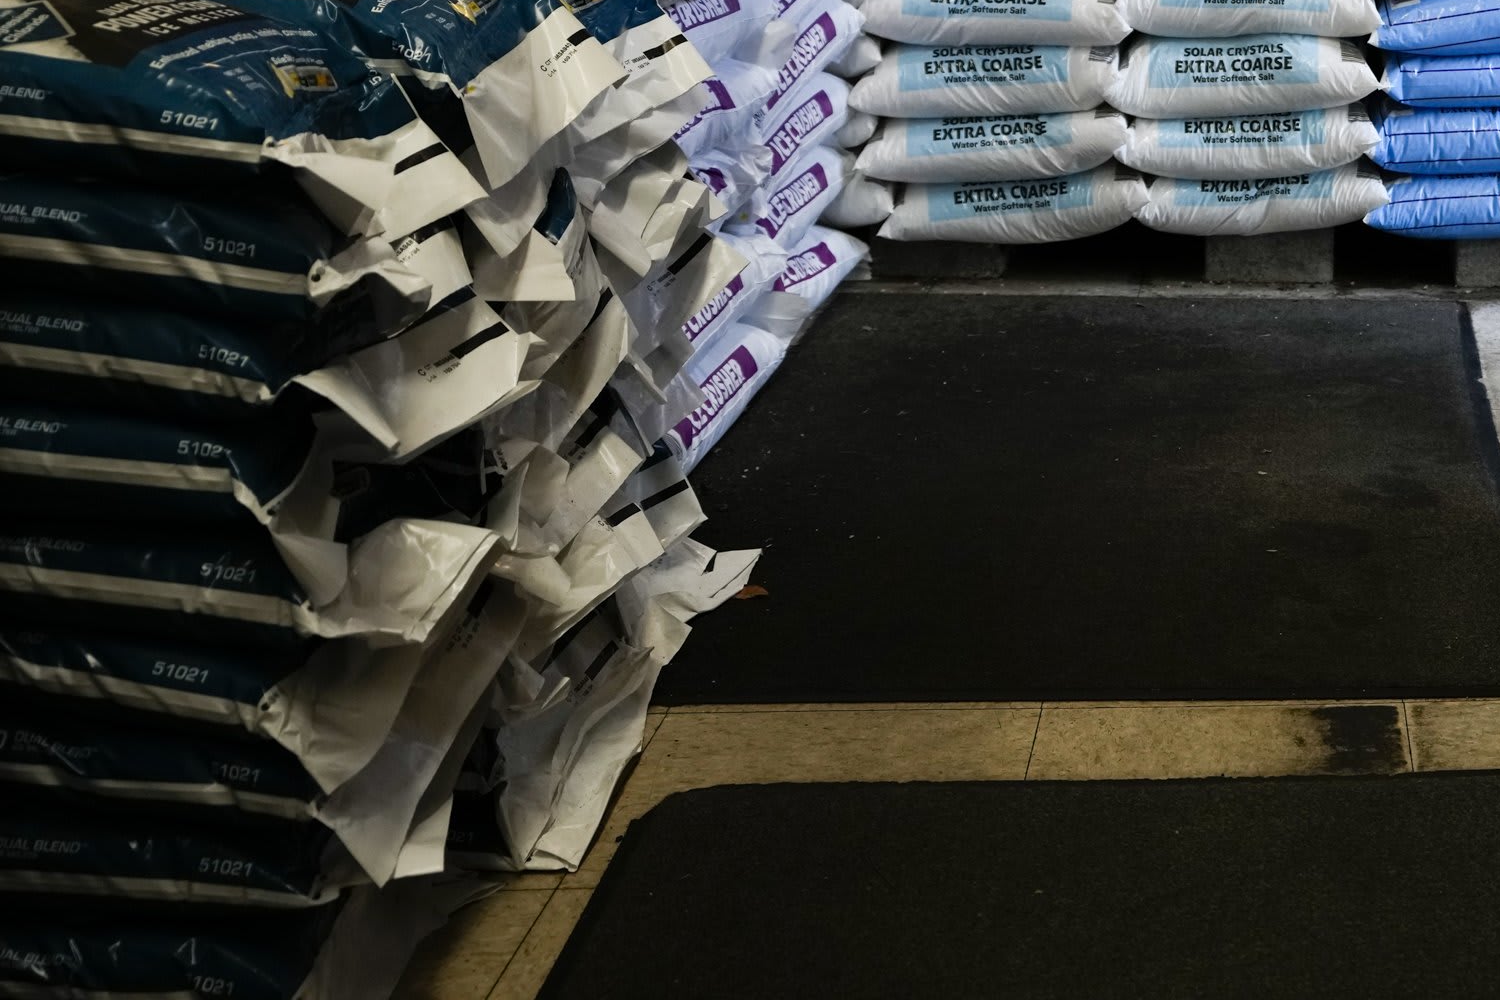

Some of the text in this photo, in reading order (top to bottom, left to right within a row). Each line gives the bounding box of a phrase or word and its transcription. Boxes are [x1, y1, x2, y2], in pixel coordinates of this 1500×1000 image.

[177, 8, 244, 25] MELTER
[1009, 7, 1026, 15] Salt
[932, 47, 973, 58] SOLAR
[1184, 44, 1284, 57] SOLAR CRYSTALS
[924, 56, 1043, 74] EXTRA COARSE
[1175, 56, 1293, 74] EXTRA COARSE
[944, 73, 1025, 84] Water Salt
[1193, 73, 1274, 83] Water Softener Salt
[0, 85, 46, 100] BLEND
[160, 110, 218, 131] 51021
[1184, 119, 1300, 134] EXTRA COARSE
[933, 127, 985, 141] EXTRA
[1203, 136, 1228, 144] Water
[1230, 135, 1265, 143] Softener
[952, 137, 1035, 150] Water Salt
[954, 188, 1006, 204] EXTRA
[1218, 194, 1242, 202] Water
[31, 205, 81, 223] BLEND
[973, 200, 1050, 213] Water Salt
[203, 236, 256, 257] 51021
[35, 314, 84, 332] BLEND
[198, 344, 249, 369] 51021
[13, 418, 60, 433] BLEND
[200, 561, 256, 583] 51021
[152, 661, 209, 684] 51021
[33, 839, 81, 854] BLEND
[199, 857, 253, 877] 51021
